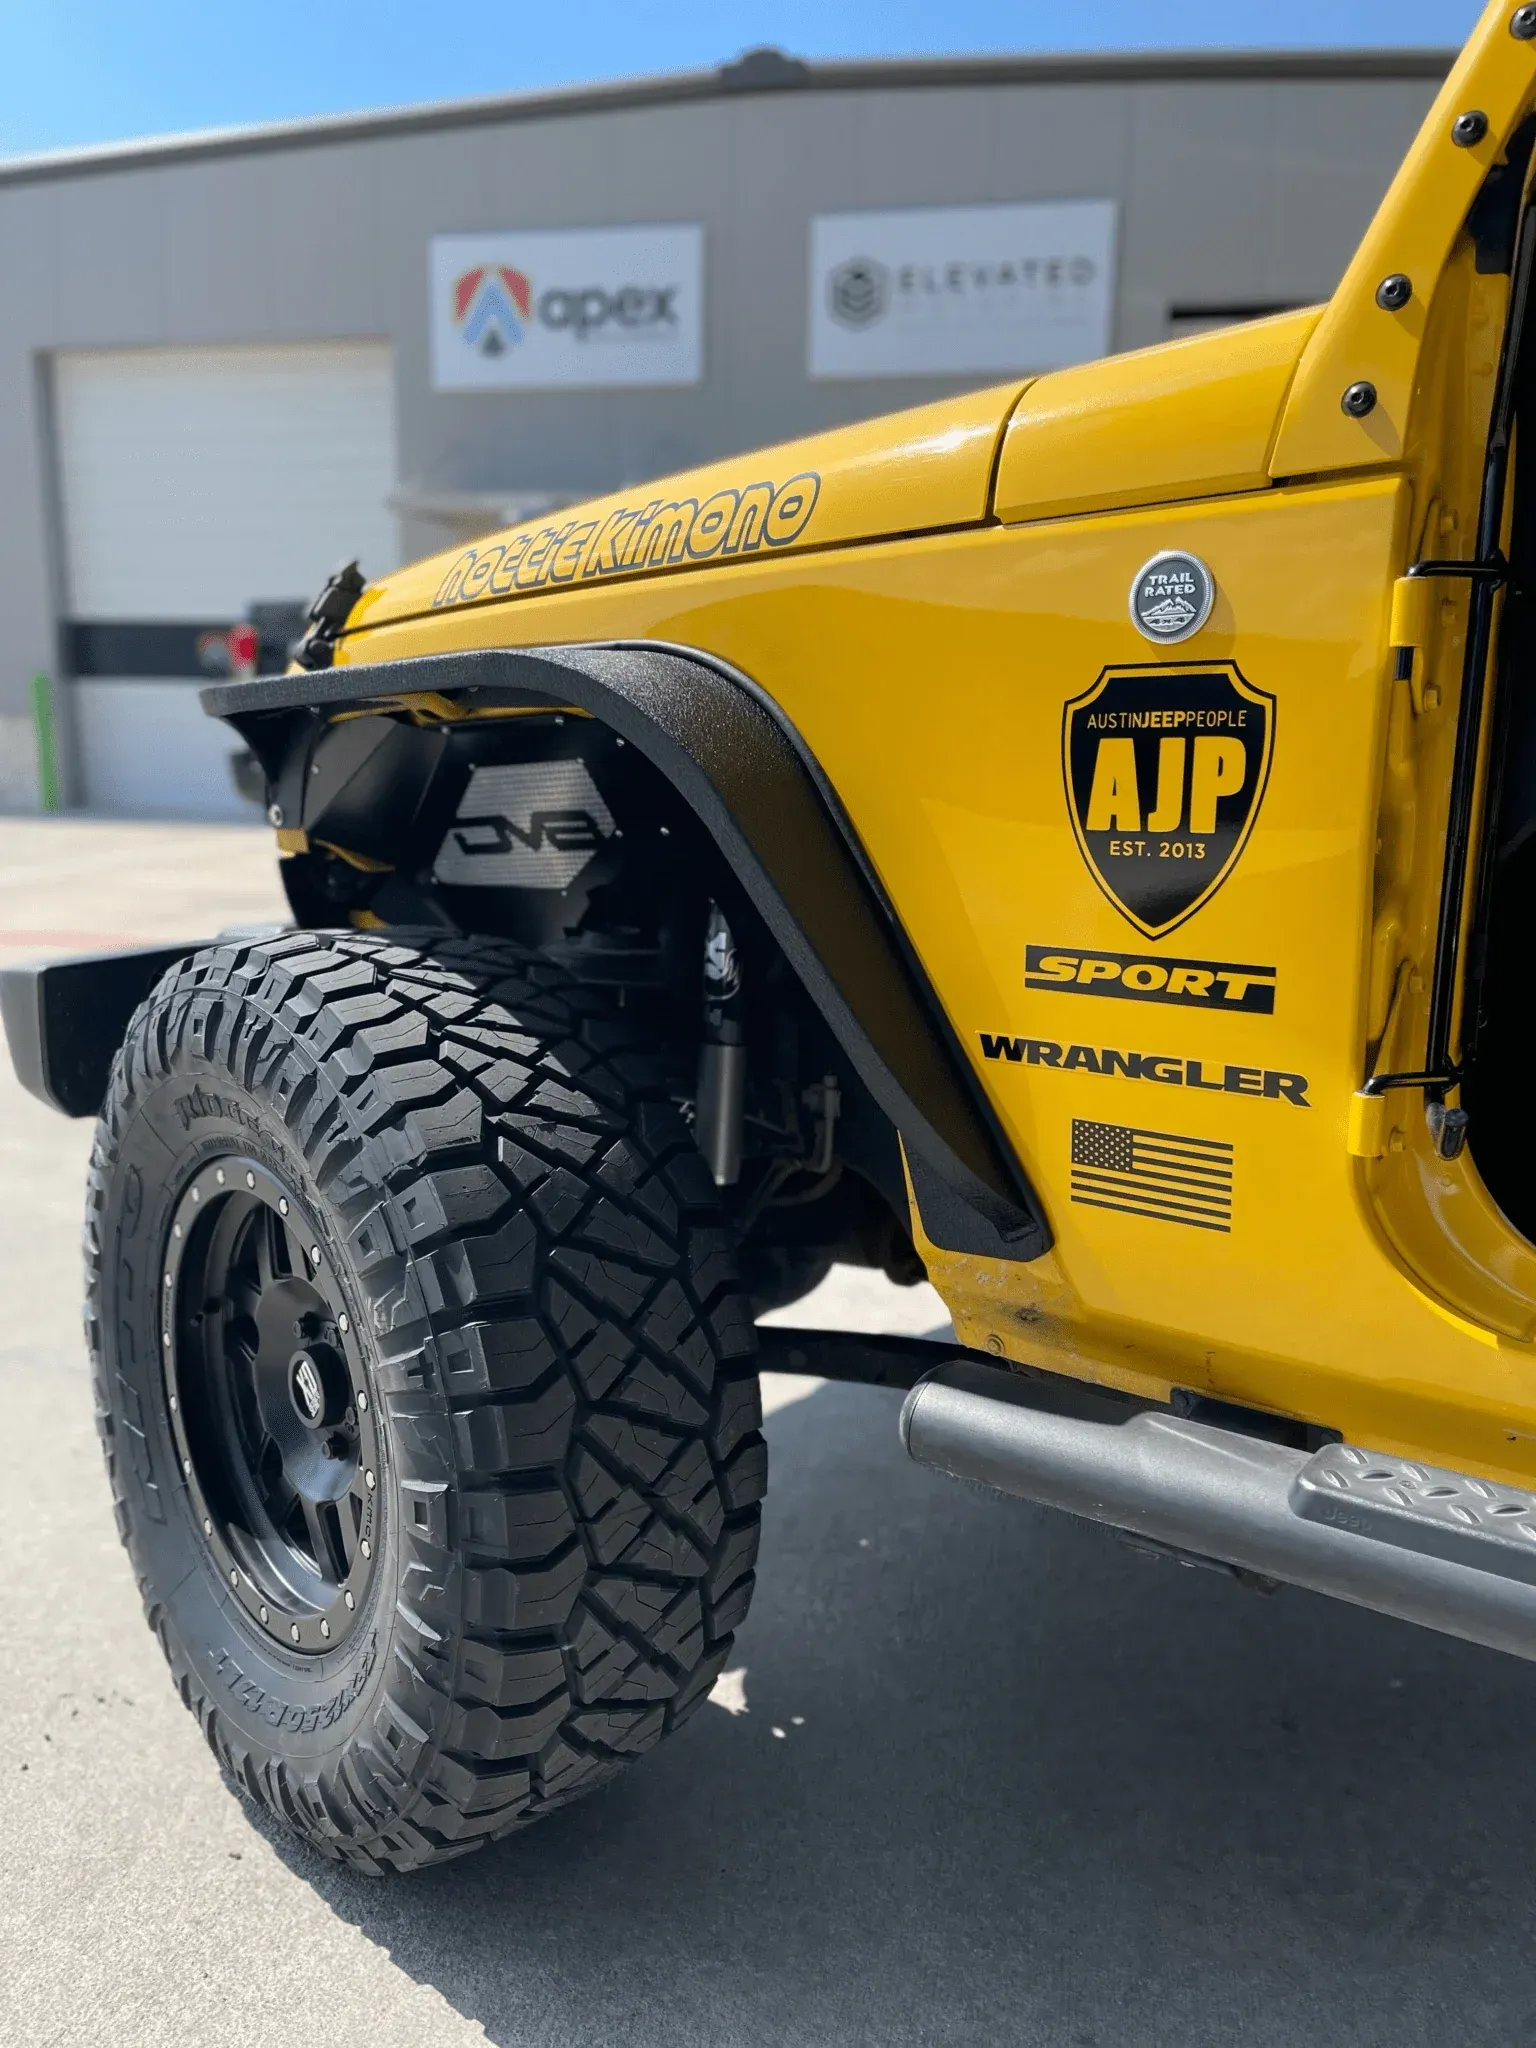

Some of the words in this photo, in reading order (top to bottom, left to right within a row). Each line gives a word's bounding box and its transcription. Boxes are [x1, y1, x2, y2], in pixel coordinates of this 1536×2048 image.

[899, 257, 1095, 294] ELEVATED
[540, 288, 678, 341] apex
[1143, 583, 1197, 598] RATED
[1148, 572, 1195, 586] TRAIL
[1086, 710, 1248, 729] AUSTINJEEPPEOPLE
[1085, 735, 1247, 834] AJP
[1109, 840, 1151, 857] EST.
[1159, 842, 1206, 859] 2013
[1036, 956, 1276, 1001] SPORT
[978, 1032, 1314, 1110] WRANGLER
[366, 1492, 374, 1538] KMC
